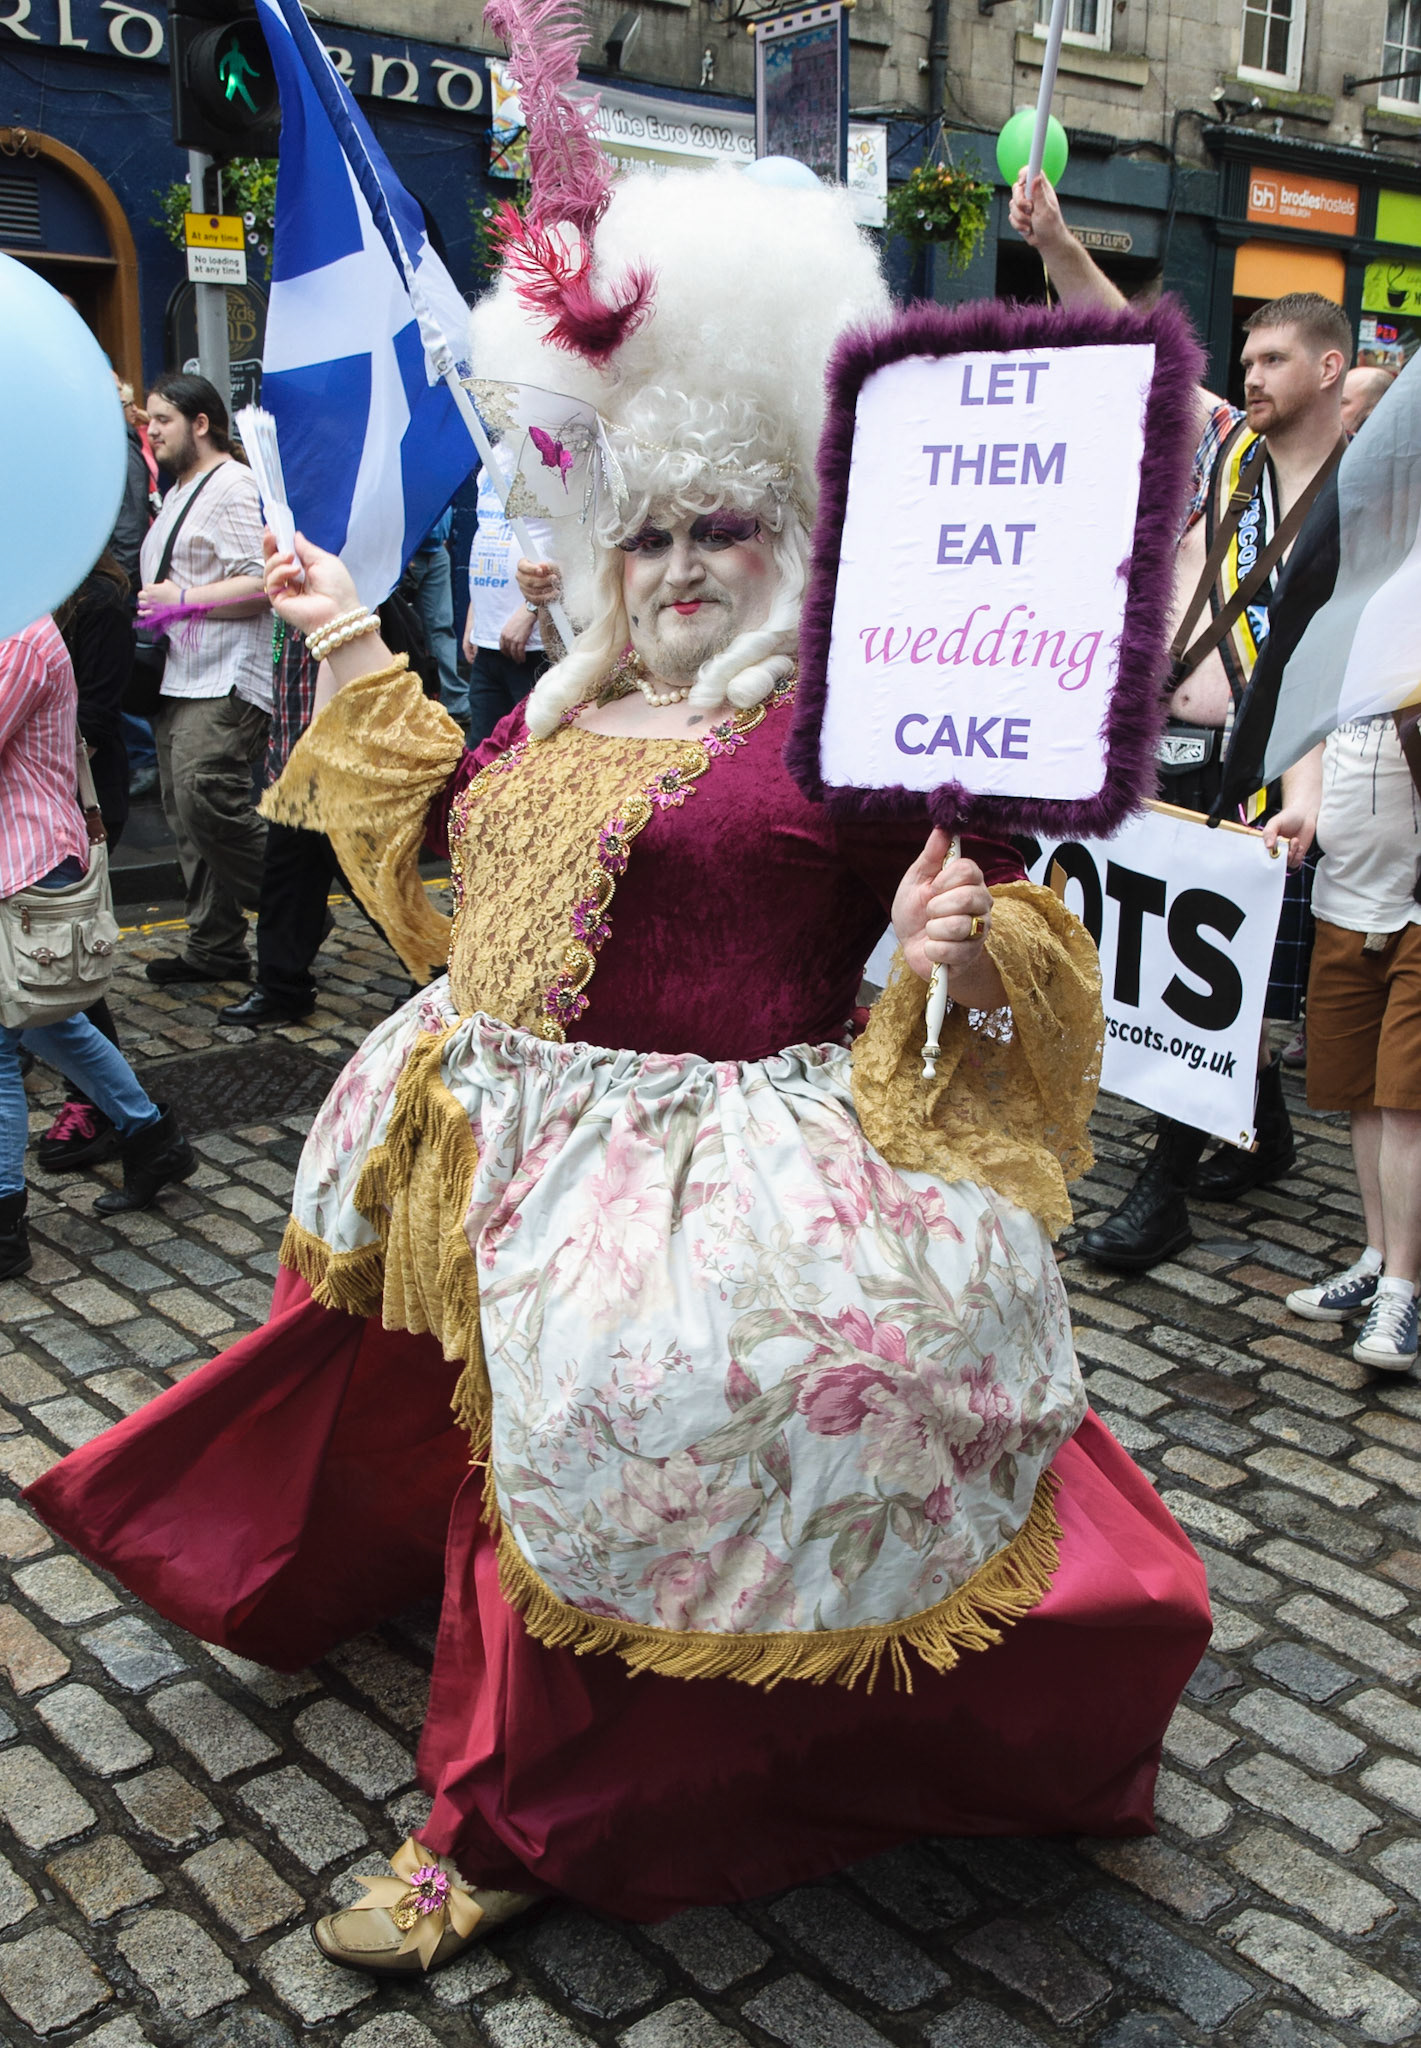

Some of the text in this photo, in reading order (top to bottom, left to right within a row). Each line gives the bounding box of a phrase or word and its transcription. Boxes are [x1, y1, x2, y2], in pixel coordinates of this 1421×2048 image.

[612, 109, 644, 137] the
[647, 115, 688, 144] Euro
[690, 123, 735, 151] 2012
[1253, 185, 1274, 208] bh
[191, 231, 239, 244] At any time
[194, 255, 239, 267] No loading
[194, 265, 240, 275] at any time
[960, 362, 1050, 406] LET
[922, 442, 1067, 486] THEM
[936, 523, 1036, 566] EAT
[474, 575, 509, 588] safer
[859, 604, 1104, 692] wedding
[894, 713, 1032, 760] CAKE
[1010, 836, 1247, 1031] OTS
